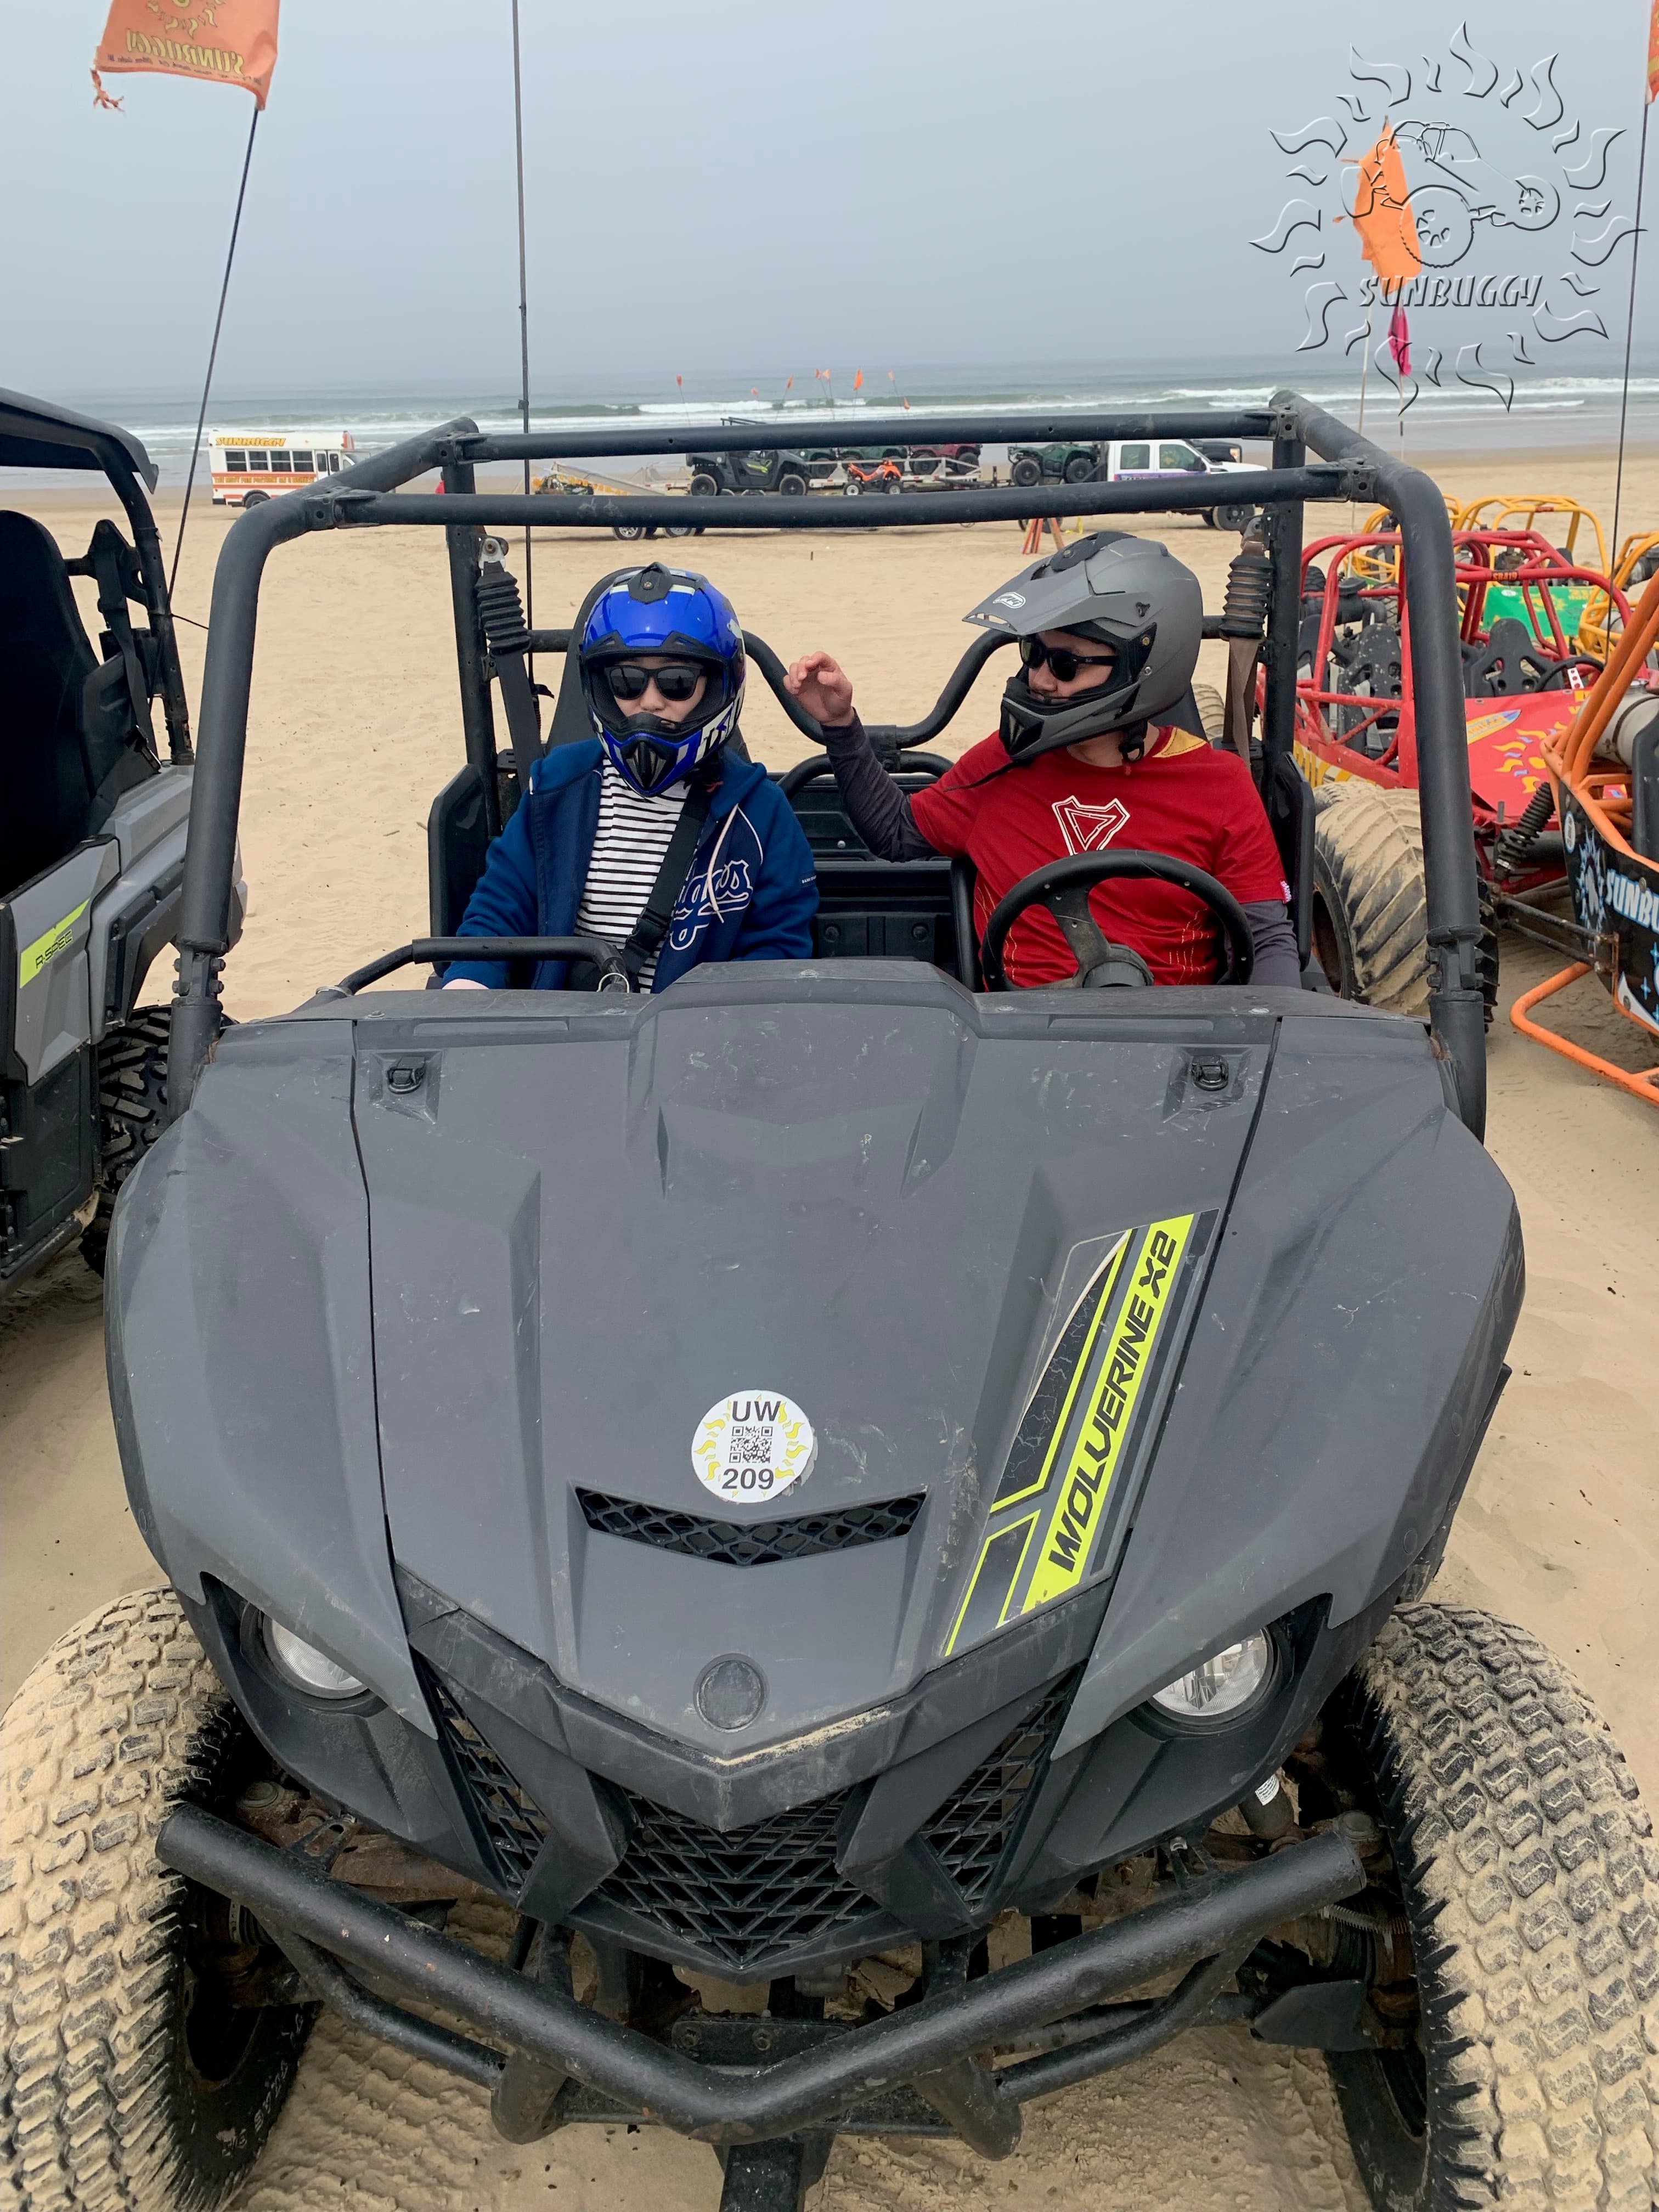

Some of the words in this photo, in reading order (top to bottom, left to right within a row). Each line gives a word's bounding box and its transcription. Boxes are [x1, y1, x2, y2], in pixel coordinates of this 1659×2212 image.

[216, 437, 287, 447] SUNBUGGY
[731, 1400, 782, 1422] UW
[1048, 1295, 1154, 1573] WOLVERINE
[1138, 1229, 1177, 1300] X2
[721, 1468, 774, 1490] 209
